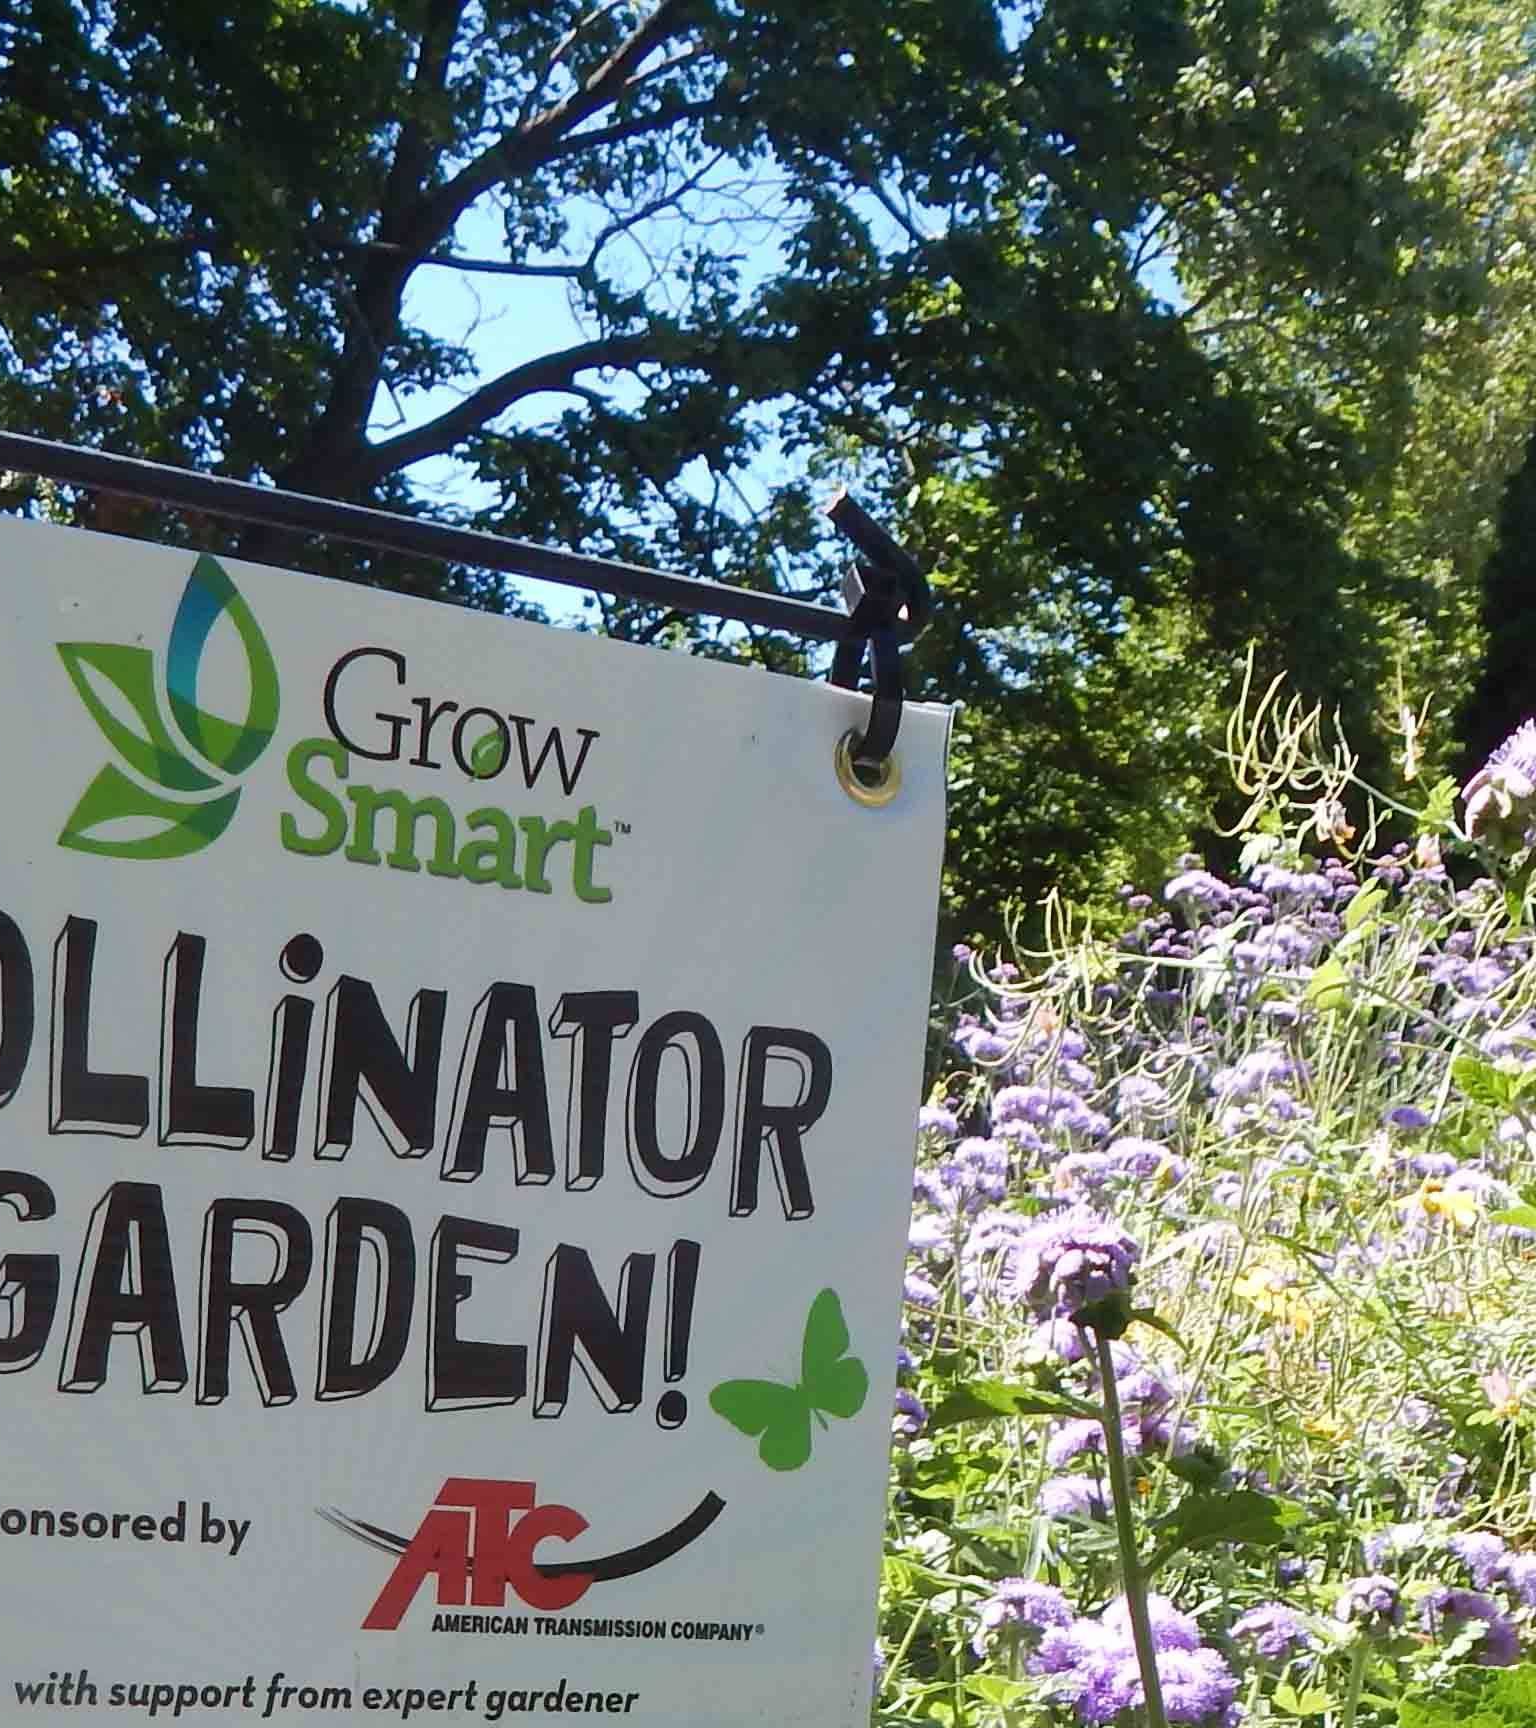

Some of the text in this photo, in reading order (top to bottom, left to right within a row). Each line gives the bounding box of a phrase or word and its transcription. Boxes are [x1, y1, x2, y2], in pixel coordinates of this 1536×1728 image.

[323, 647, 600, 796] Grow
[201, 1504, 251, 1554] by
[361, 1477, 597, 1630] ATC
[431, 1614, 530, 1634] AMERICAN
[534, 1617, 666, 1638] TRANSMISSION
[15, 1672, 638, 1720] with support from expert gardener
